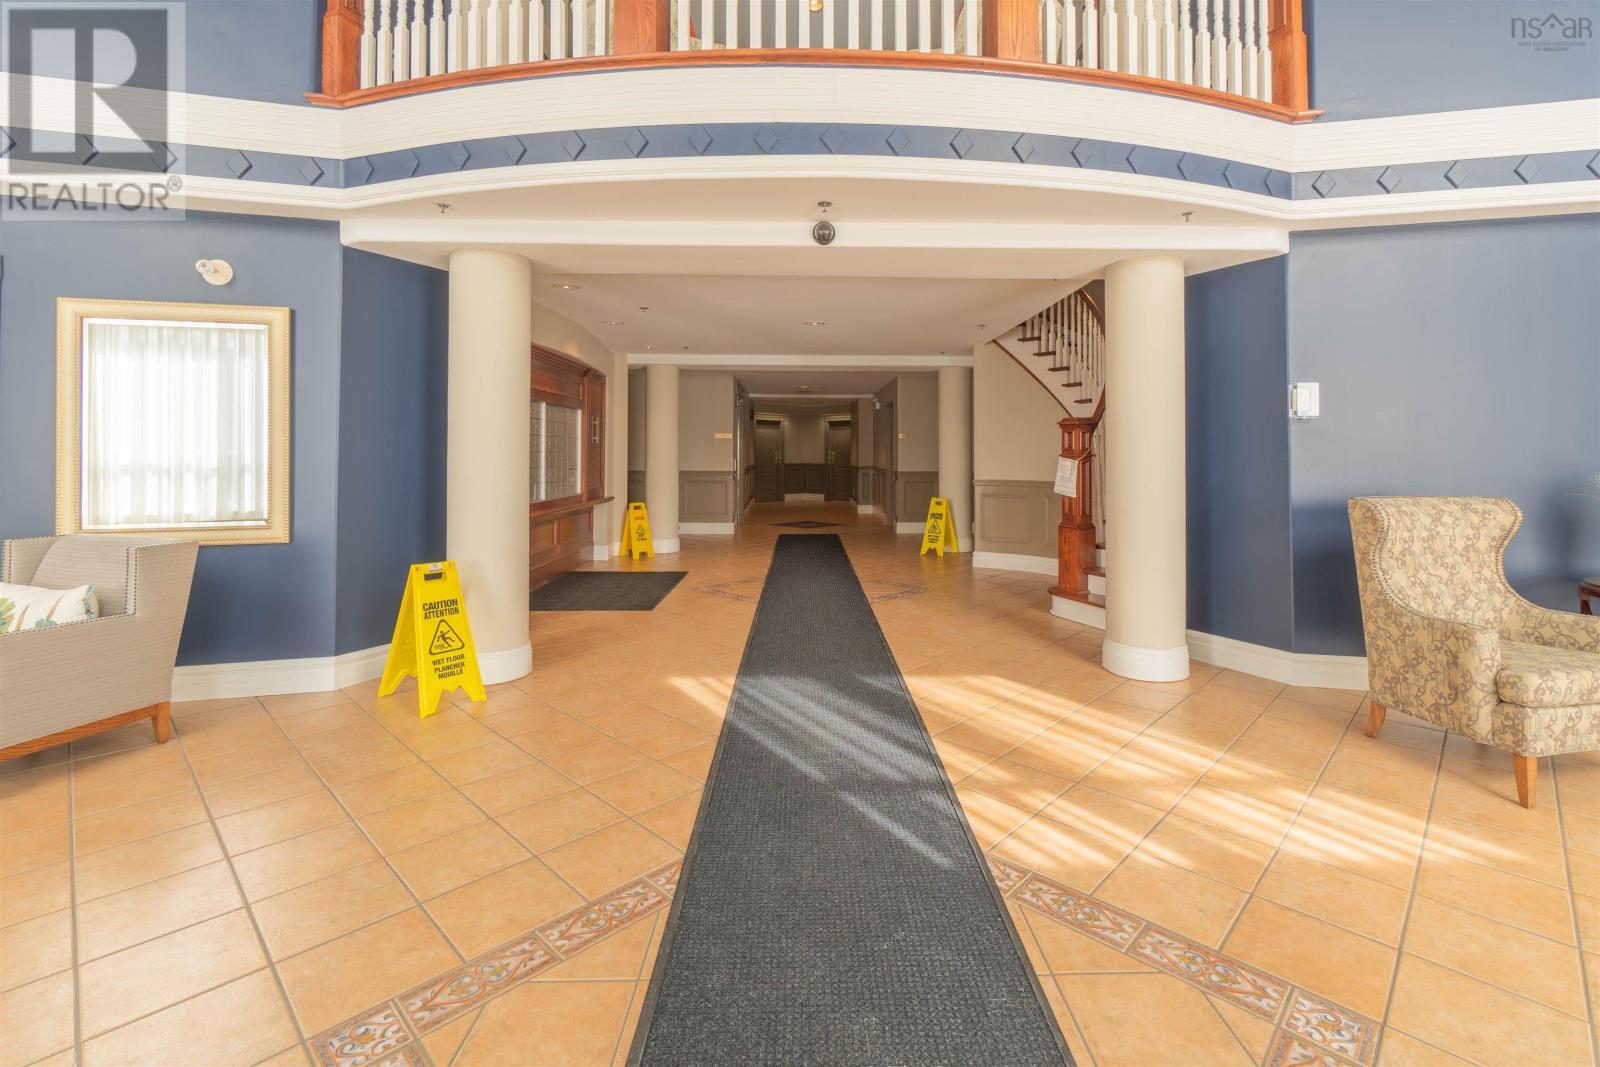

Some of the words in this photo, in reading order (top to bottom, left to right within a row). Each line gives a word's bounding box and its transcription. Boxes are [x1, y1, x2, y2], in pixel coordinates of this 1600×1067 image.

[422, 599, 458, 611] CAUTION
[424, 607, 459, 620] ATTENTION
[432, 658, 445, 666] WET
[446, 653, 465, 663] FLOOR
[434, 662, 465, 673] PLANCHER
